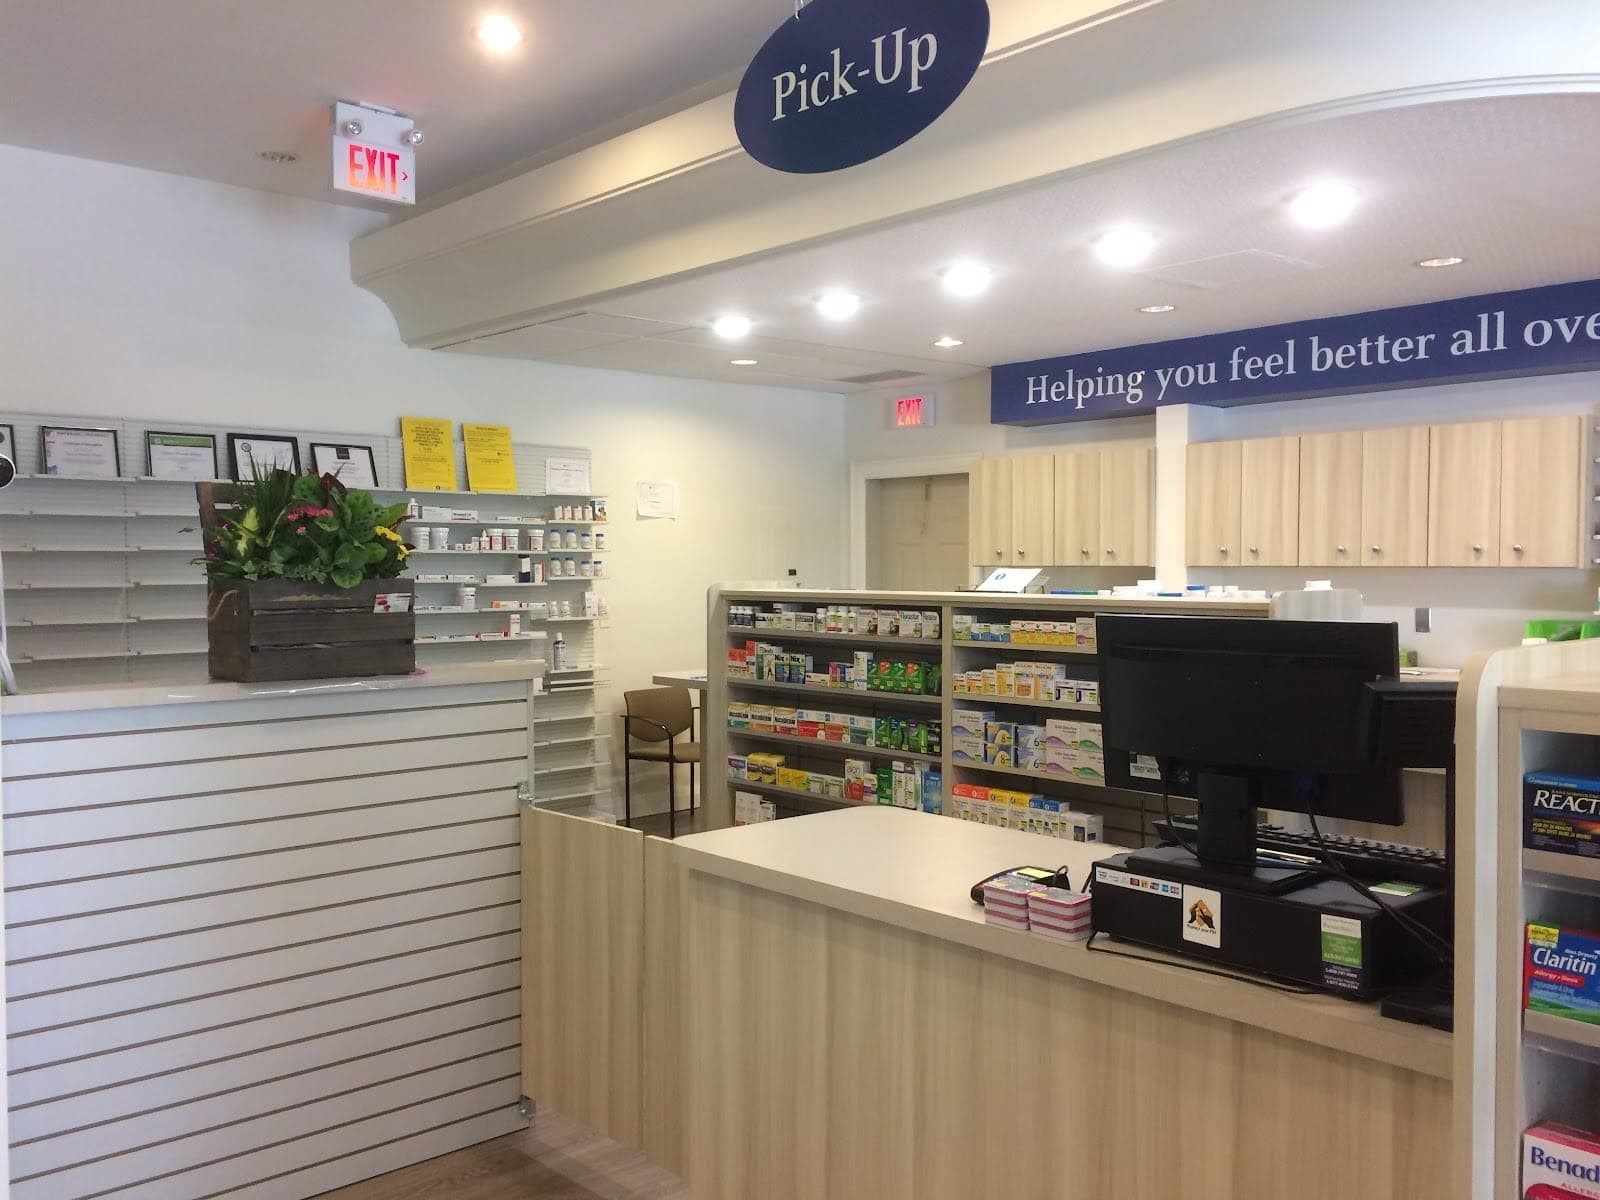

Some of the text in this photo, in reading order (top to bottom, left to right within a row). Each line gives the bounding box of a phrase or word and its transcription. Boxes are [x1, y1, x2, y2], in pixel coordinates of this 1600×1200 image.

[772, 27, 938, 121] Pick-Up
[348, 144, 400, 196] EXIT
[1026, 366, 1146, 409] Helping
[1154, 361, 1218, 401] you
[1228, 338, 1296, 382] feel
[1309, 333, 1436, 372] better
[1450, 311, 1508, 356] all
[896, 398, 923, 426] EXIT
[790, 655, 801, 664] Nix
[1033, 737, 1040, 747] 6
[1033, 758, 1040, 768] 6
[1534, 789, 1600, 815] REACT
[1533, 947, 1597, 976] Claritin
[1534, 970, 1557, 980] Allergy
[1531, 1146, 1600, 1184] Benad
